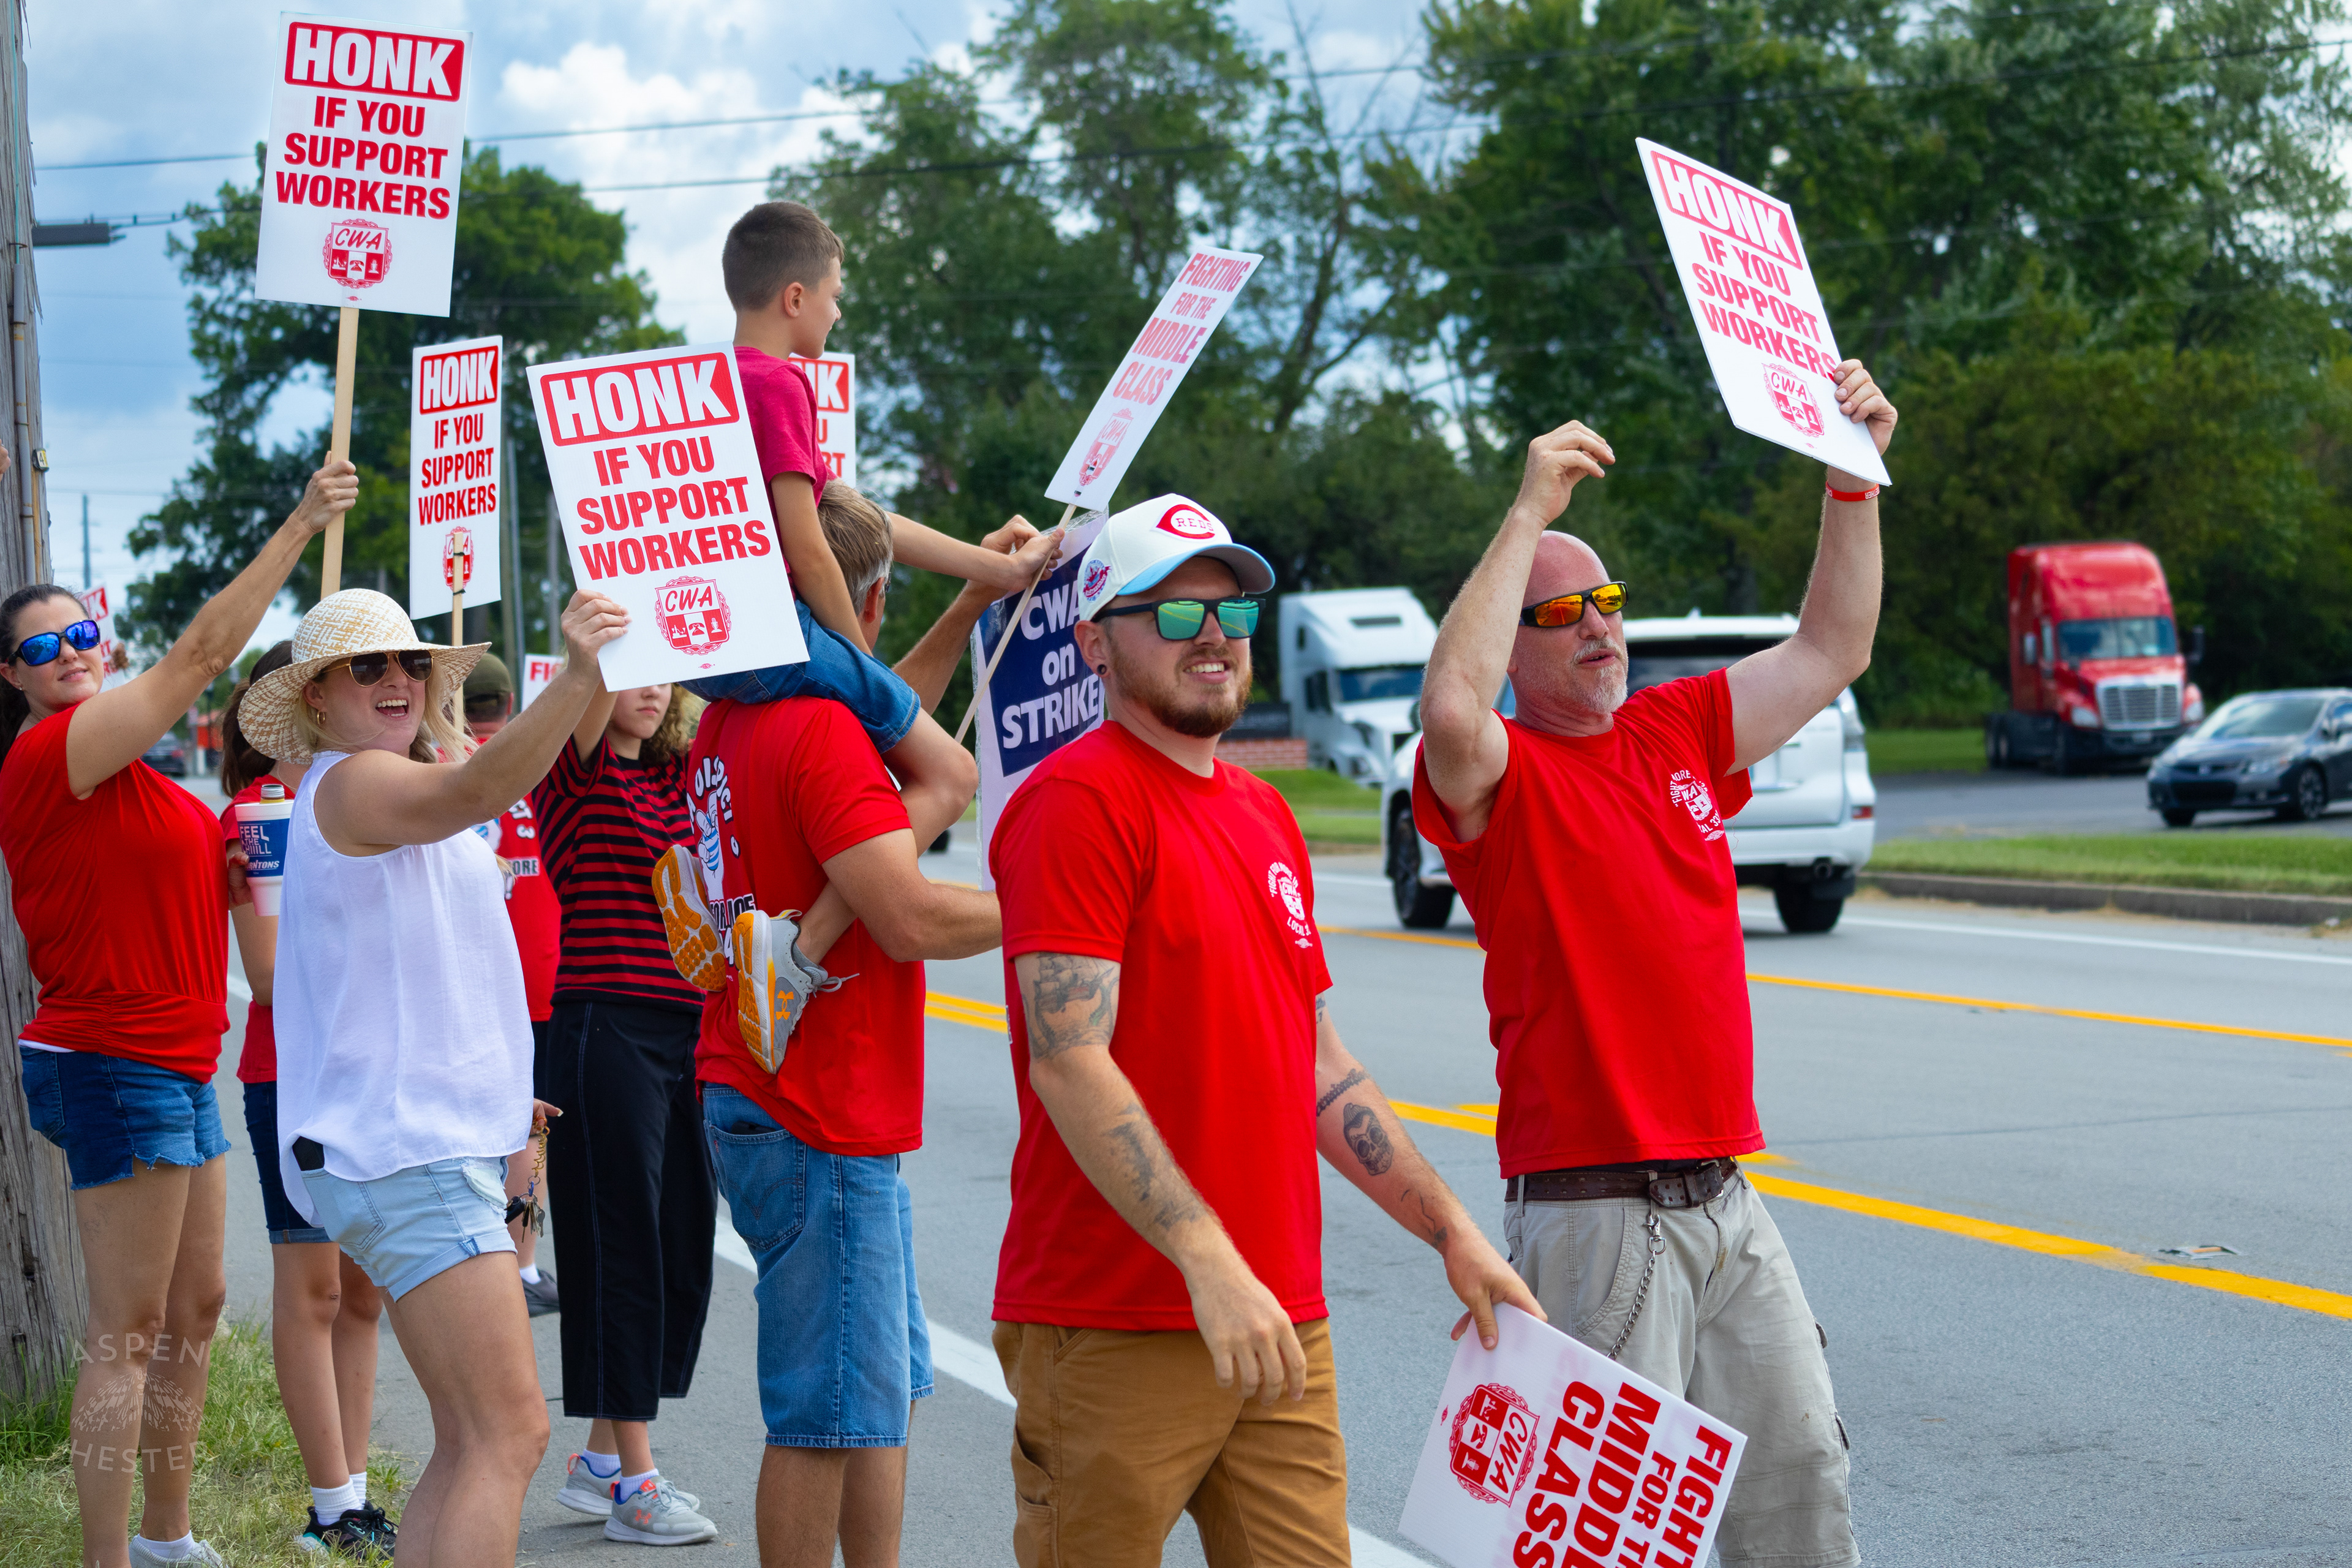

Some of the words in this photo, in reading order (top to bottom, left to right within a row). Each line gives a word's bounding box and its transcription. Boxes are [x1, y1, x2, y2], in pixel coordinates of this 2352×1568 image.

[292, 28, 456, 97] HONK
[314, 96, 347, 128] IF
[356, 100, 426, 137] YOU
[284, 132, 448, 179] SUPPORT
[276, 171, 451, 220] WORKERS
[1656, 157, 1798, 264] HONK
[334, 228, 382, 251] CWA
[1177, 252, 1251, 293] FIGHTING
[1698, 230, 1728, 267] IF
[1734, 244, 1791, 296] YOU
[1170, 292, 1199, 318] FOR
[1190, 296, 1218, 320] THE
[1691, 262, 1822, 344] SUPPORT
[1132, 317, 1207, 364] MIDDLE
[1697, 298, 1838, 381] WORKERS
[422, 349, 496, 410] HONK
[549, 360, 731, 440] HONK
[1112, 361, 1173, 405] CLASS
[1770, 372, 1808, 402] CWA
[434, 418, 449, 450] IF
[453, 413, 484, 446] YOU
[1101, 419, 1129, 442] CWA
[421, 447, 494, 489] SUPPORT
[593, 447, 630, 487] IF
[636, 435, 715, 479] YOU
[418, 483, 497, 526] WORKERS
[576, 477, 749, 535] SUPPORT
[1175, 518, 1214, 532] REDS
[448, 535, 469, 556] CA
[578, 520, 771, 581] WORKERS
[665, 586, 713, 612] CWA
[1042, 642, 1075, 686] on
[1001, 673, 1099, 749] STRIKE
[1681, 785, 1698, 801] WA
[239, 825, 270, 842] FEEL
[510, 858, 539, 876] ORE
[1287, 916, 1305, 937] LOCAL
[1489, 1411, 1528, 1494] CWA
[1631, 1450, 1677, 1530] FOR
